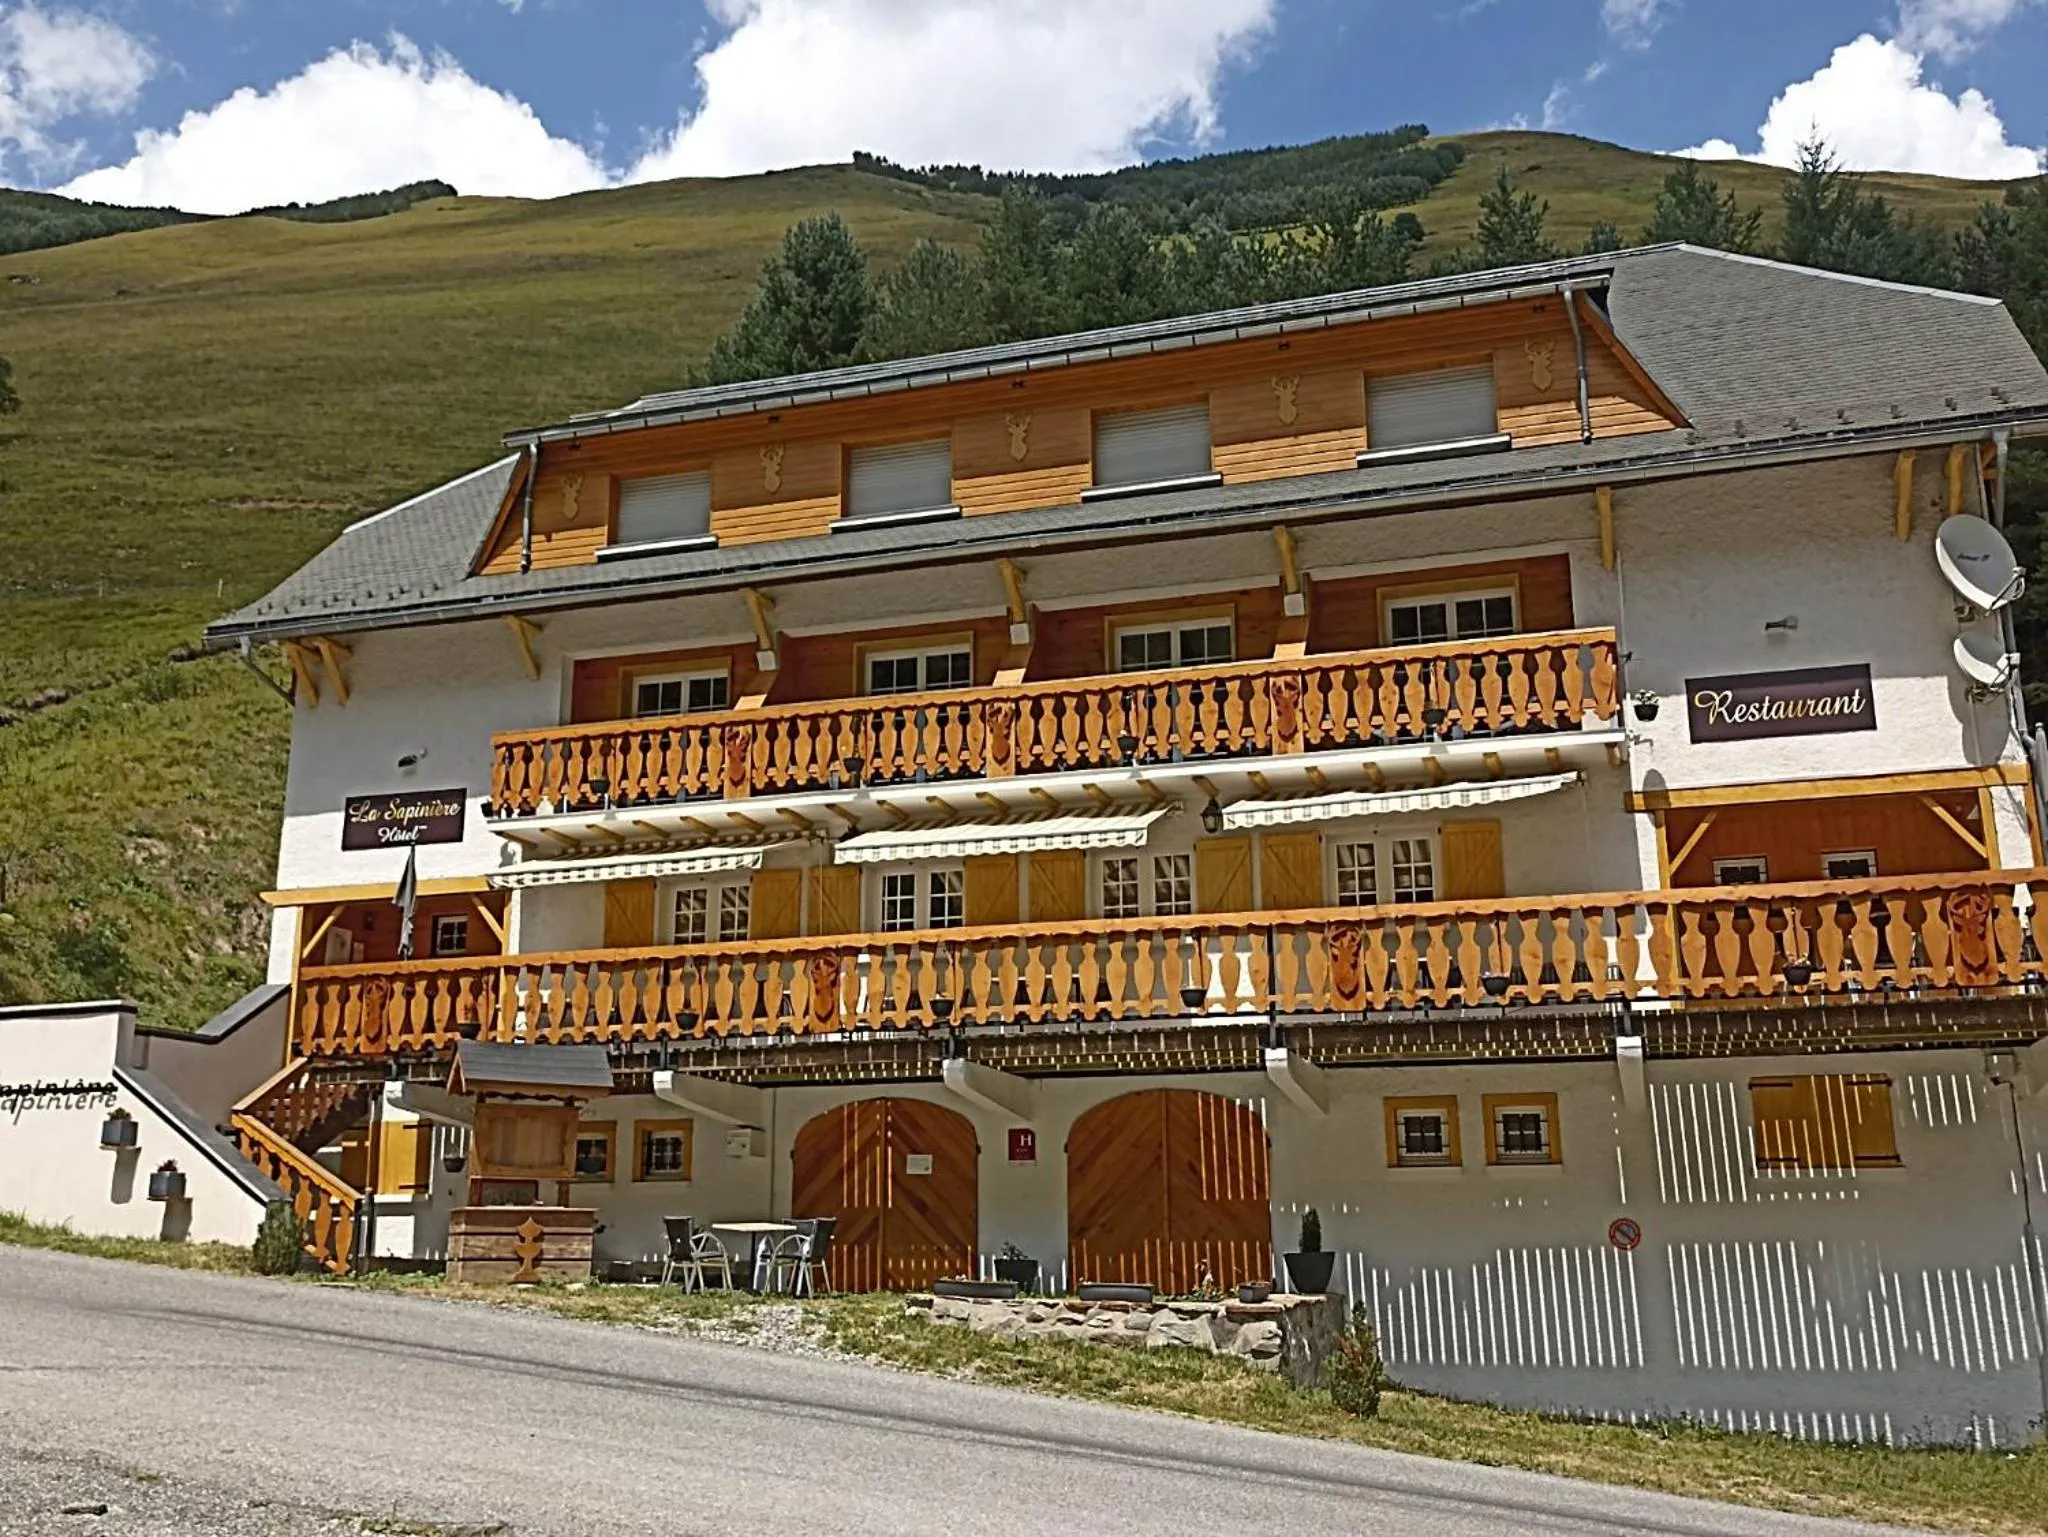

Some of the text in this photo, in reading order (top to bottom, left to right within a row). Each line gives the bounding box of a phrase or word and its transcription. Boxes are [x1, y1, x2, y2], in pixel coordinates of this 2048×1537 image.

[1694, 688, 1866, 725] Restaurant
[349, 797, 461, 826] La Sapinière
[1020, 1134, 1032, 1146] H
